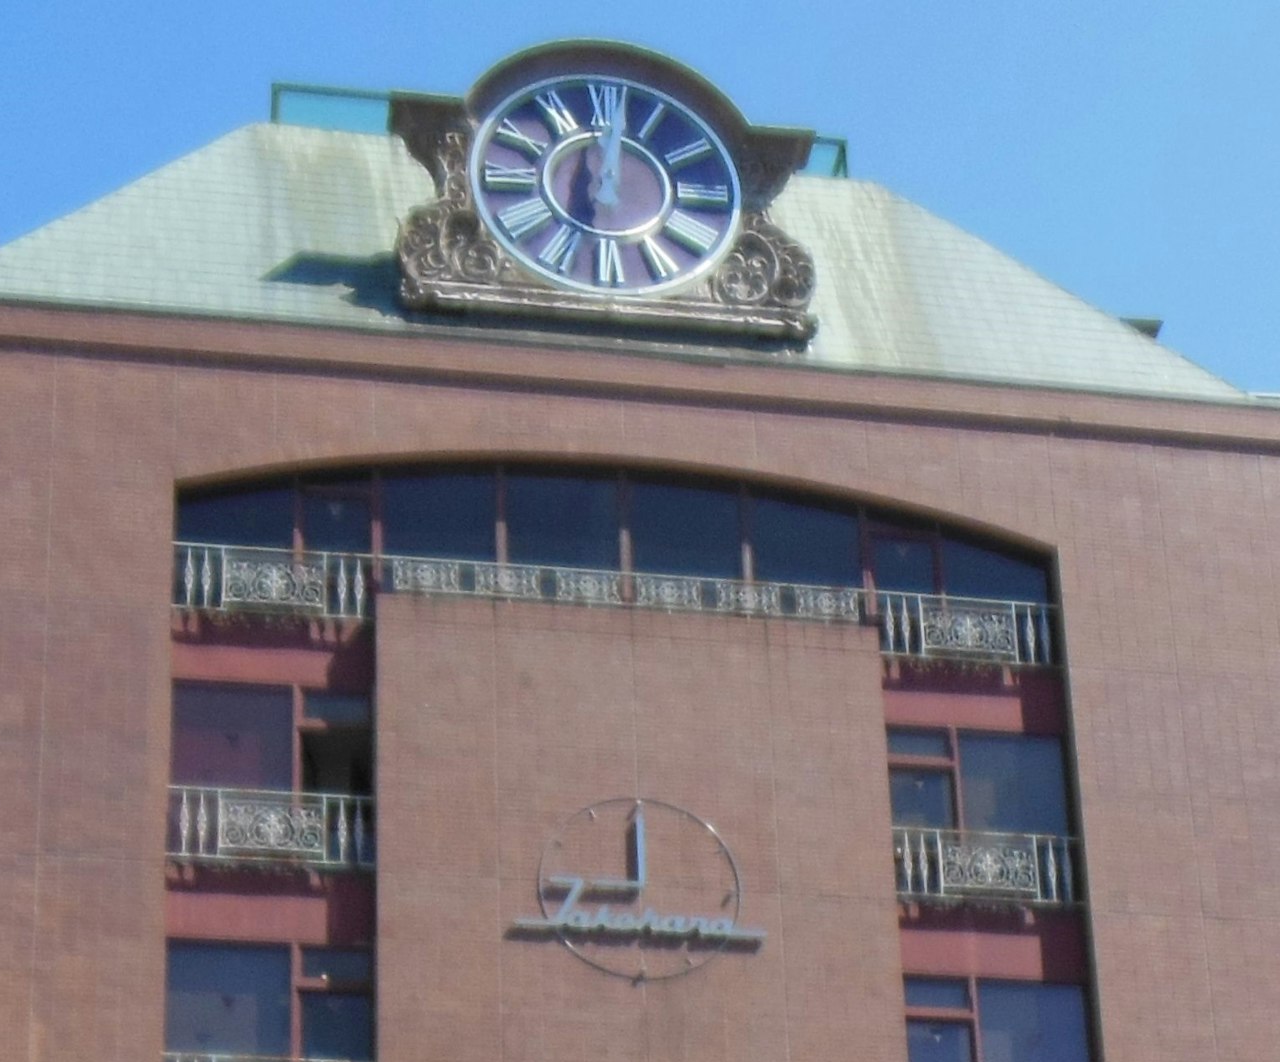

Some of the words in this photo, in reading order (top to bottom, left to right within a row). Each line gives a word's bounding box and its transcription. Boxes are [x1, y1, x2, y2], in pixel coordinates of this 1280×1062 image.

[534, 90, 579, 135] XI
[638, 103, 665, 138] I
[495, 117, 549, 156] X
[664, 137, 712, 165] II
[484, 160, 537, 185] IX
[677, 180, 729, 202] III
[496, 197, 554, 240] VIII
[538, 223, 582, 273] VII
[598, 237, 626, 284] VI
[641, 235, 680, 278] V
